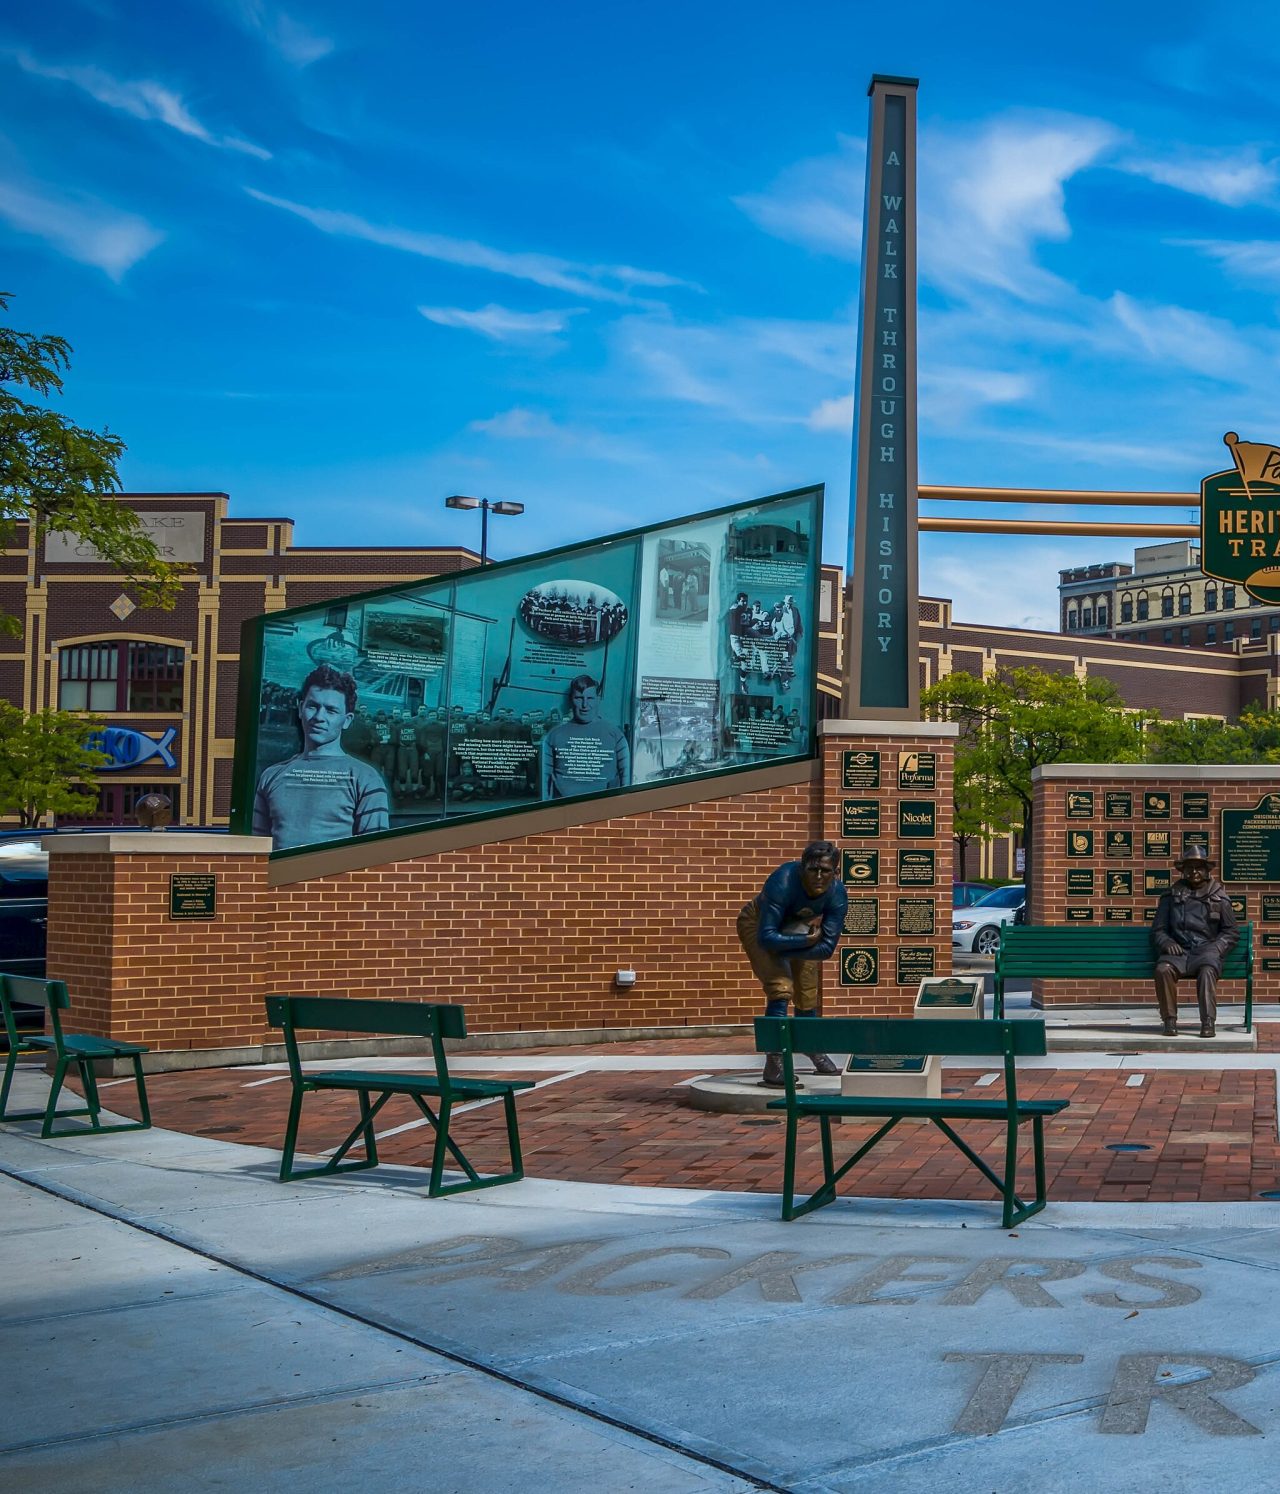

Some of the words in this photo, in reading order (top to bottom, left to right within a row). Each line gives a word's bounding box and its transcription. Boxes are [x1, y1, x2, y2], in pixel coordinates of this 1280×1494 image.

[886, 151, 900, 166] A
[883, 195, 903, 279] WALK
[880, 308, 897, 463] THROUGH
[877, 493, 895, 652] HISTORY
[901, 772, 934, 783] Performa
[902, 813, 932, 823] Nicolet
[318, 1234, 1204, 1309] PACKERS
